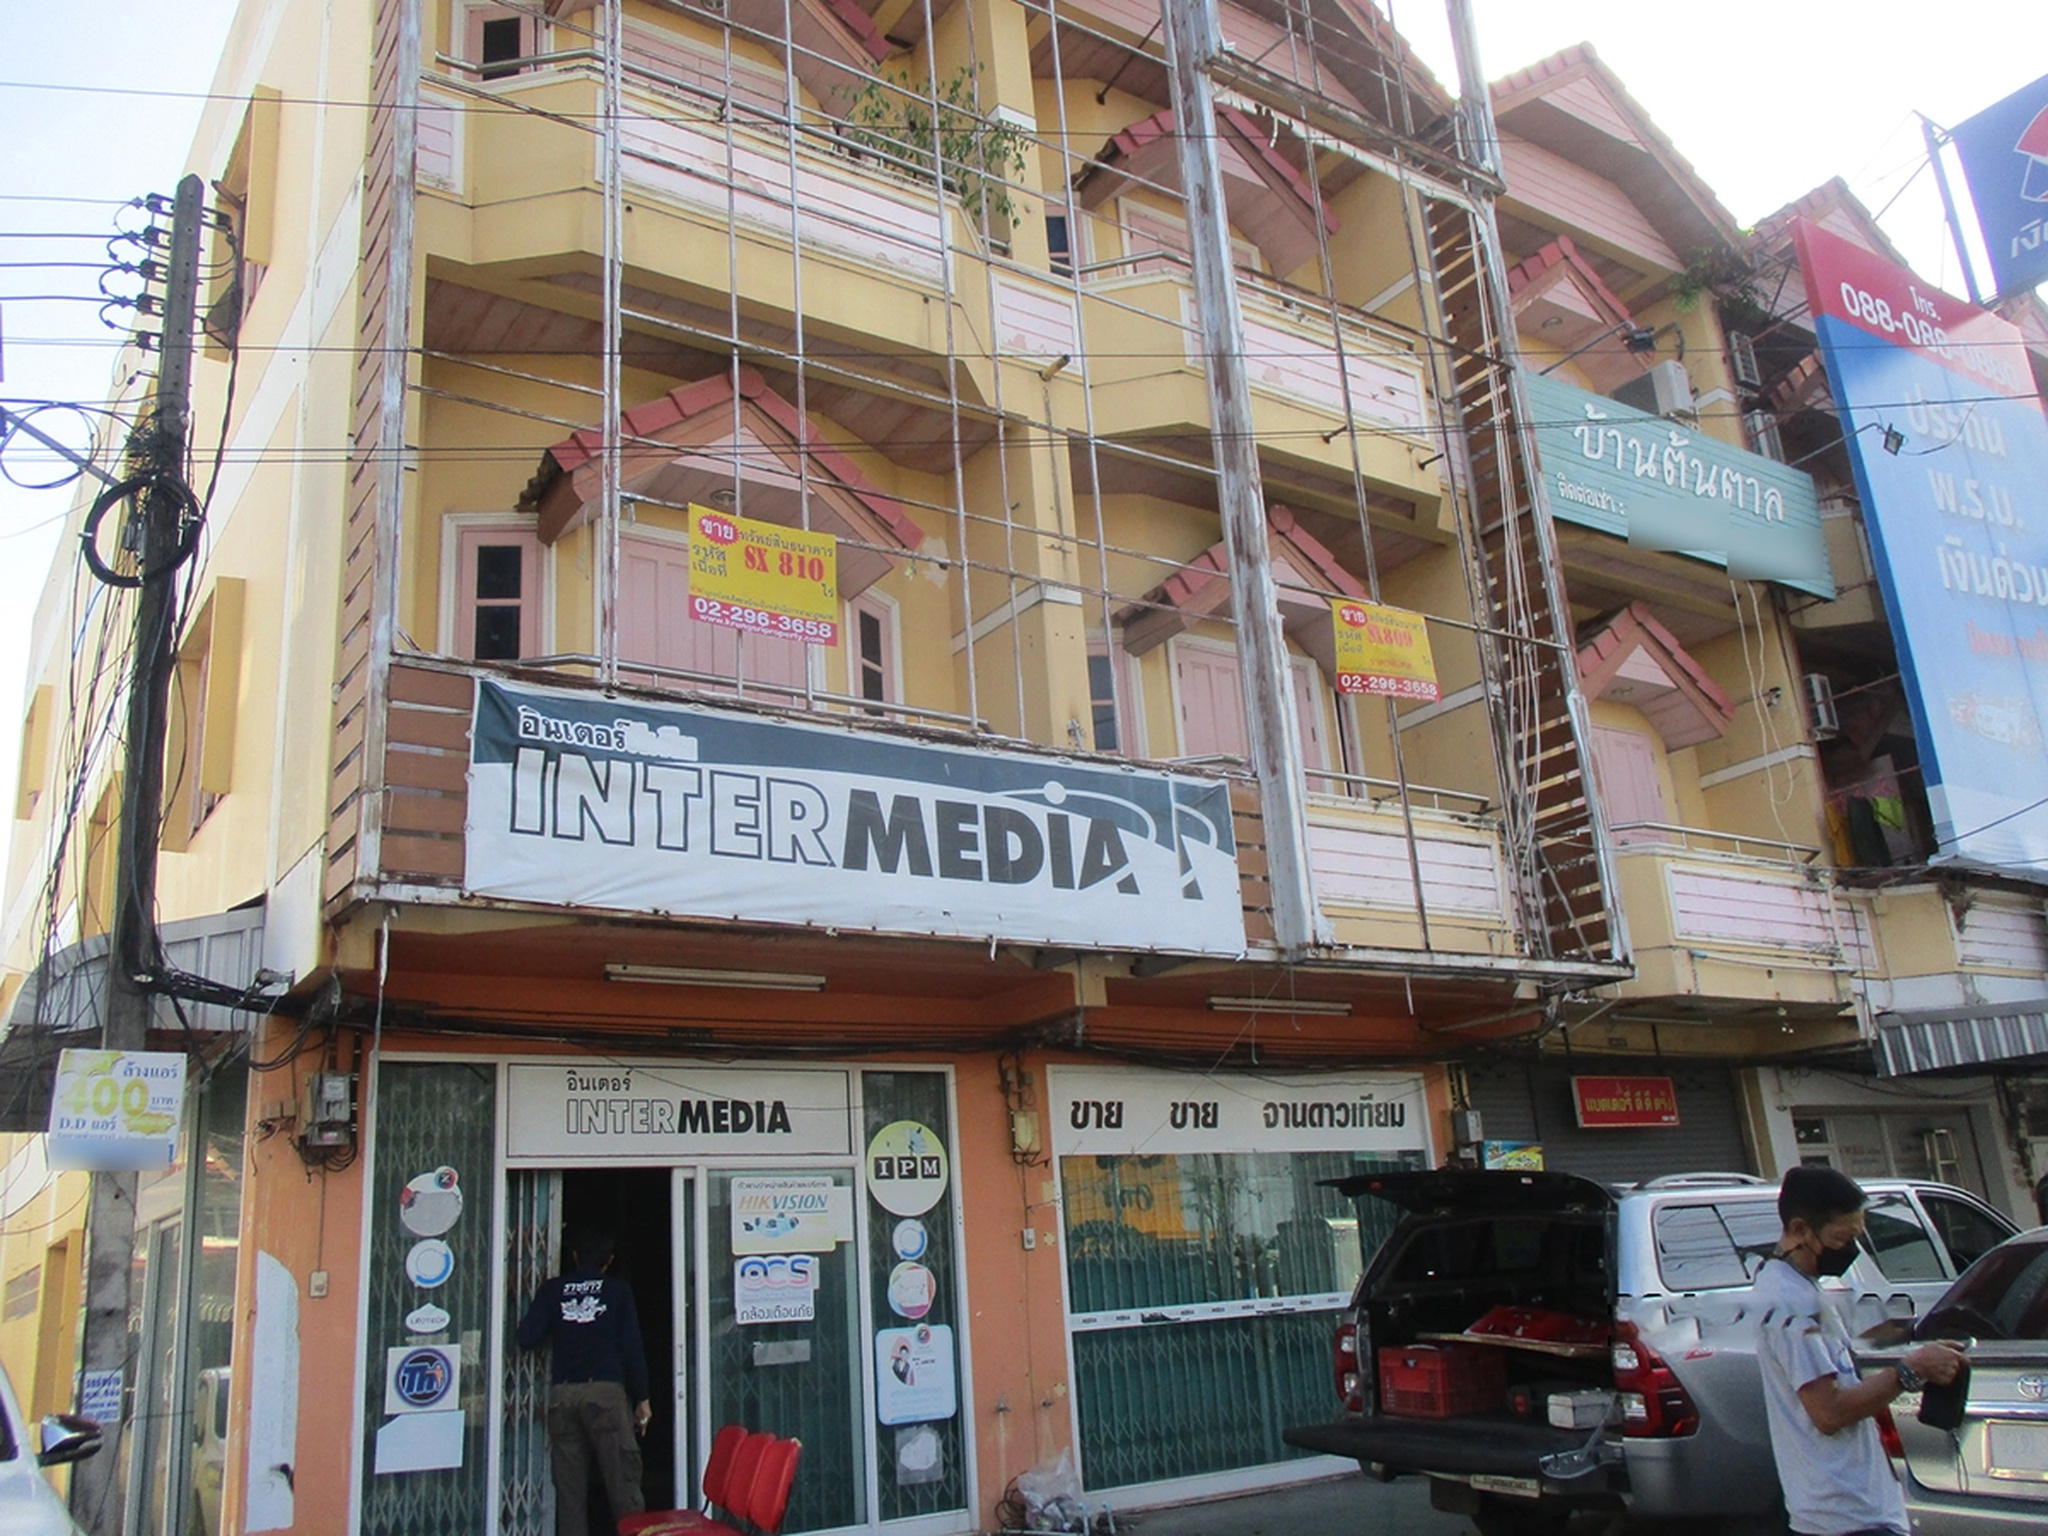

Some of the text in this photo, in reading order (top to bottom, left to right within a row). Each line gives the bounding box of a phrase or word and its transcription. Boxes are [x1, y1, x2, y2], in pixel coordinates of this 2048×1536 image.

[1573, 402, 1784, 522] บ้านต้นตาล
[701, 518, 734, 540] ขาย
[744, 545, 824, 582] SX 810
[695, 598, 831, 638] 02-296-3658
[1341, 674, 1437, 695] 02-296-3658
[60, 1076, 148, 1116] 400
[567, 1069, 632, 1092] อินเตอร์
[566, 1099, 792, 1134] INTERMEDIA
[1070, 1093, 1406, 1129] ขาย ขาย จานดาวเทียม
[878, 1160, 938, 1176] IPM
[738, 1194, 829, 1210] HIKVISION
